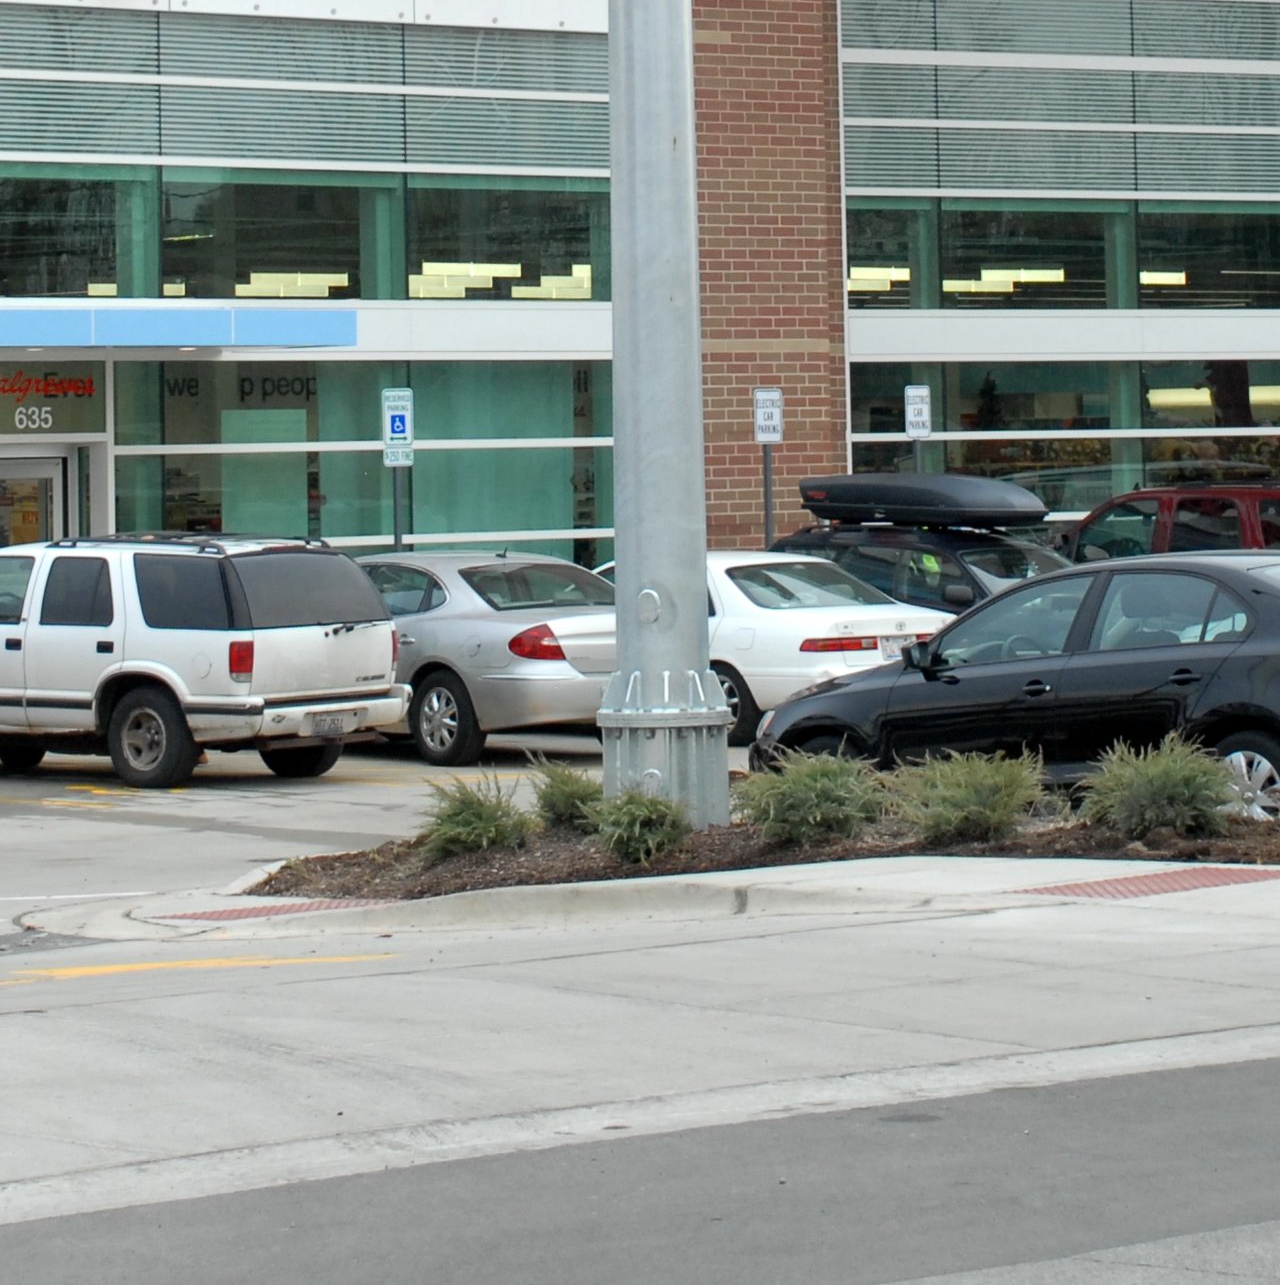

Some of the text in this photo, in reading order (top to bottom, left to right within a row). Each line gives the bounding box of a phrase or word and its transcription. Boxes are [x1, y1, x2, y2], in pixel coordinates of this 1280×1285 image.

[166, 376, 199, 397] we
[262, 376, 317, 402] peop
[383, 395, 412, 403] RESERVED
[755, 398, 781, 409] ELECTRIC
[906, 395, 929, 405] ELECTRIC
[386, 404, 409, 412] PARKING
[913, 407, 923, 417] CAR
[14, 406, 53, 429] 635
[763, 411, 773, 421] CAR
[757, 424, 780, 434] PARKING
[908, 420, 929, 430] PARKING
[401, 450, 413, 462] FINE
